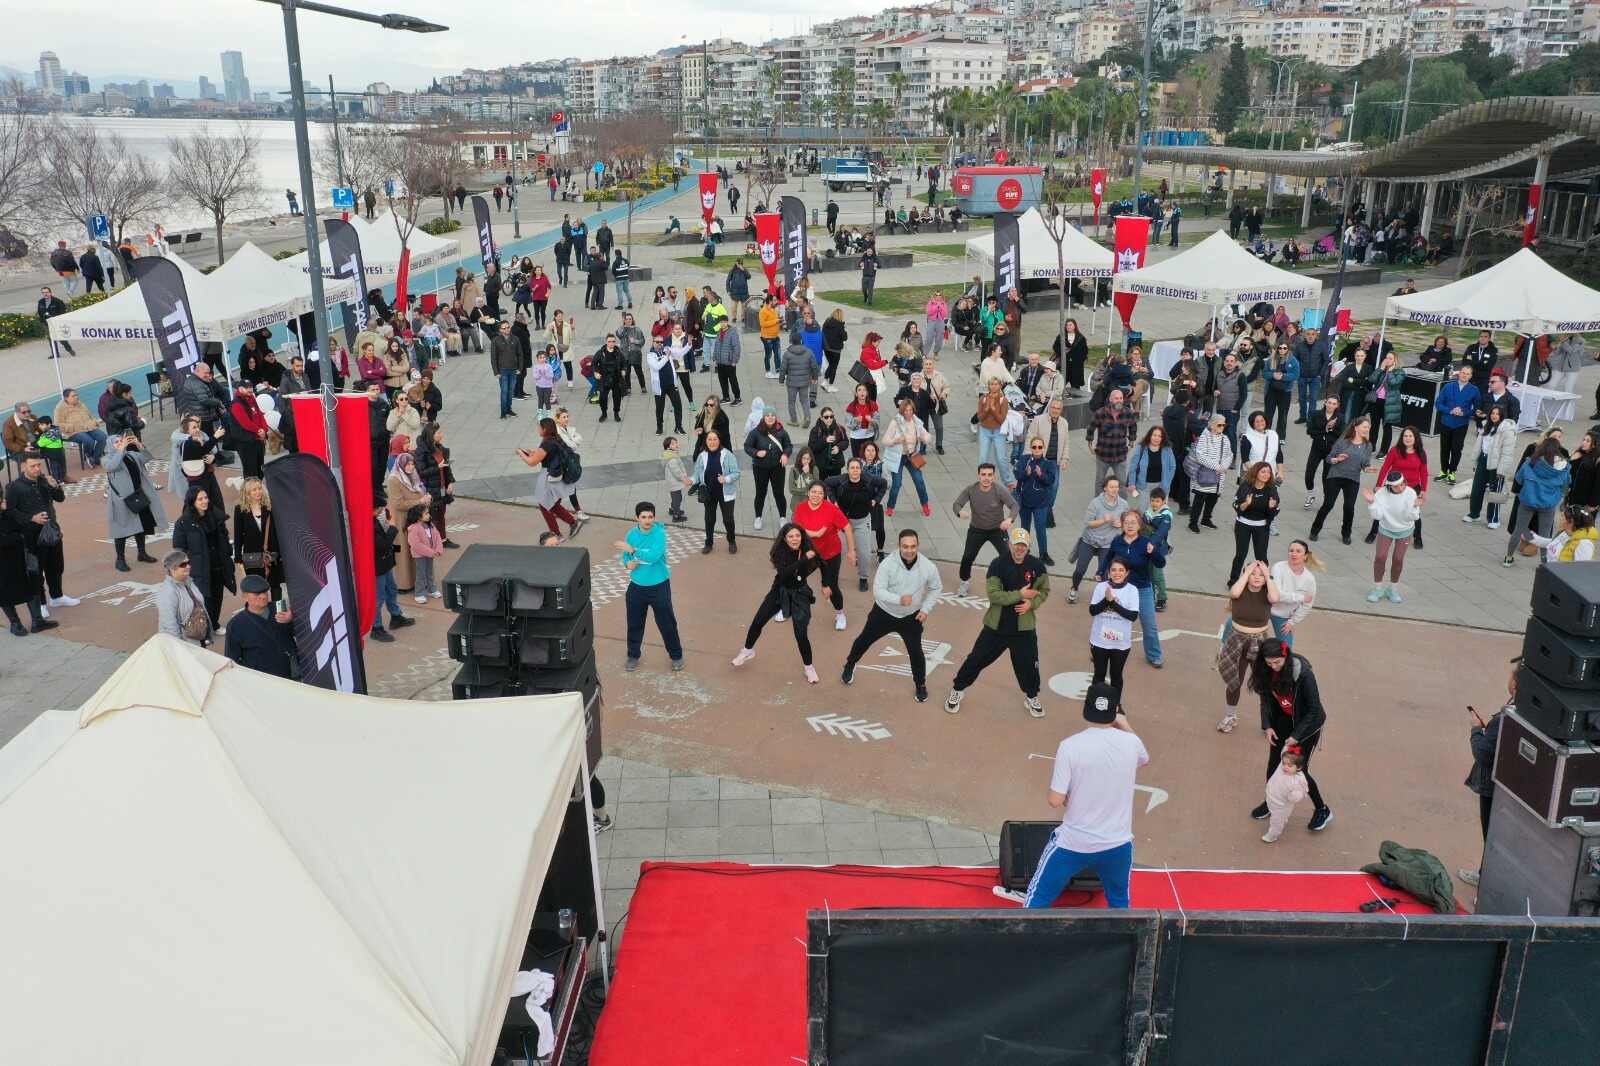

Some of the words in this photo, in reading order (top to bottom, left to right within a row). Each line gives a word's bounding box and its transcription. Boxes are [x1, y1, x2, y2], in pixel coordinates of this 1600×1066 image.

[339, 189, 346, 200] P
[95, 216, 103, 230] P
[1130, 283, 1154, 294] KONAK
[1155, 286, 1198, 300] BELEDİYESİ
[1236, 291, 1262, 303] KONAK
[1263, 288, 1305, 301] BELEDİYESİ
[1409, 311, 1442, 325] KONAK
[237, 317, 258, 334] KONAK
[1556, 321, 1585, 332] KONAK
[80, 327, 122, 339] KONAK
